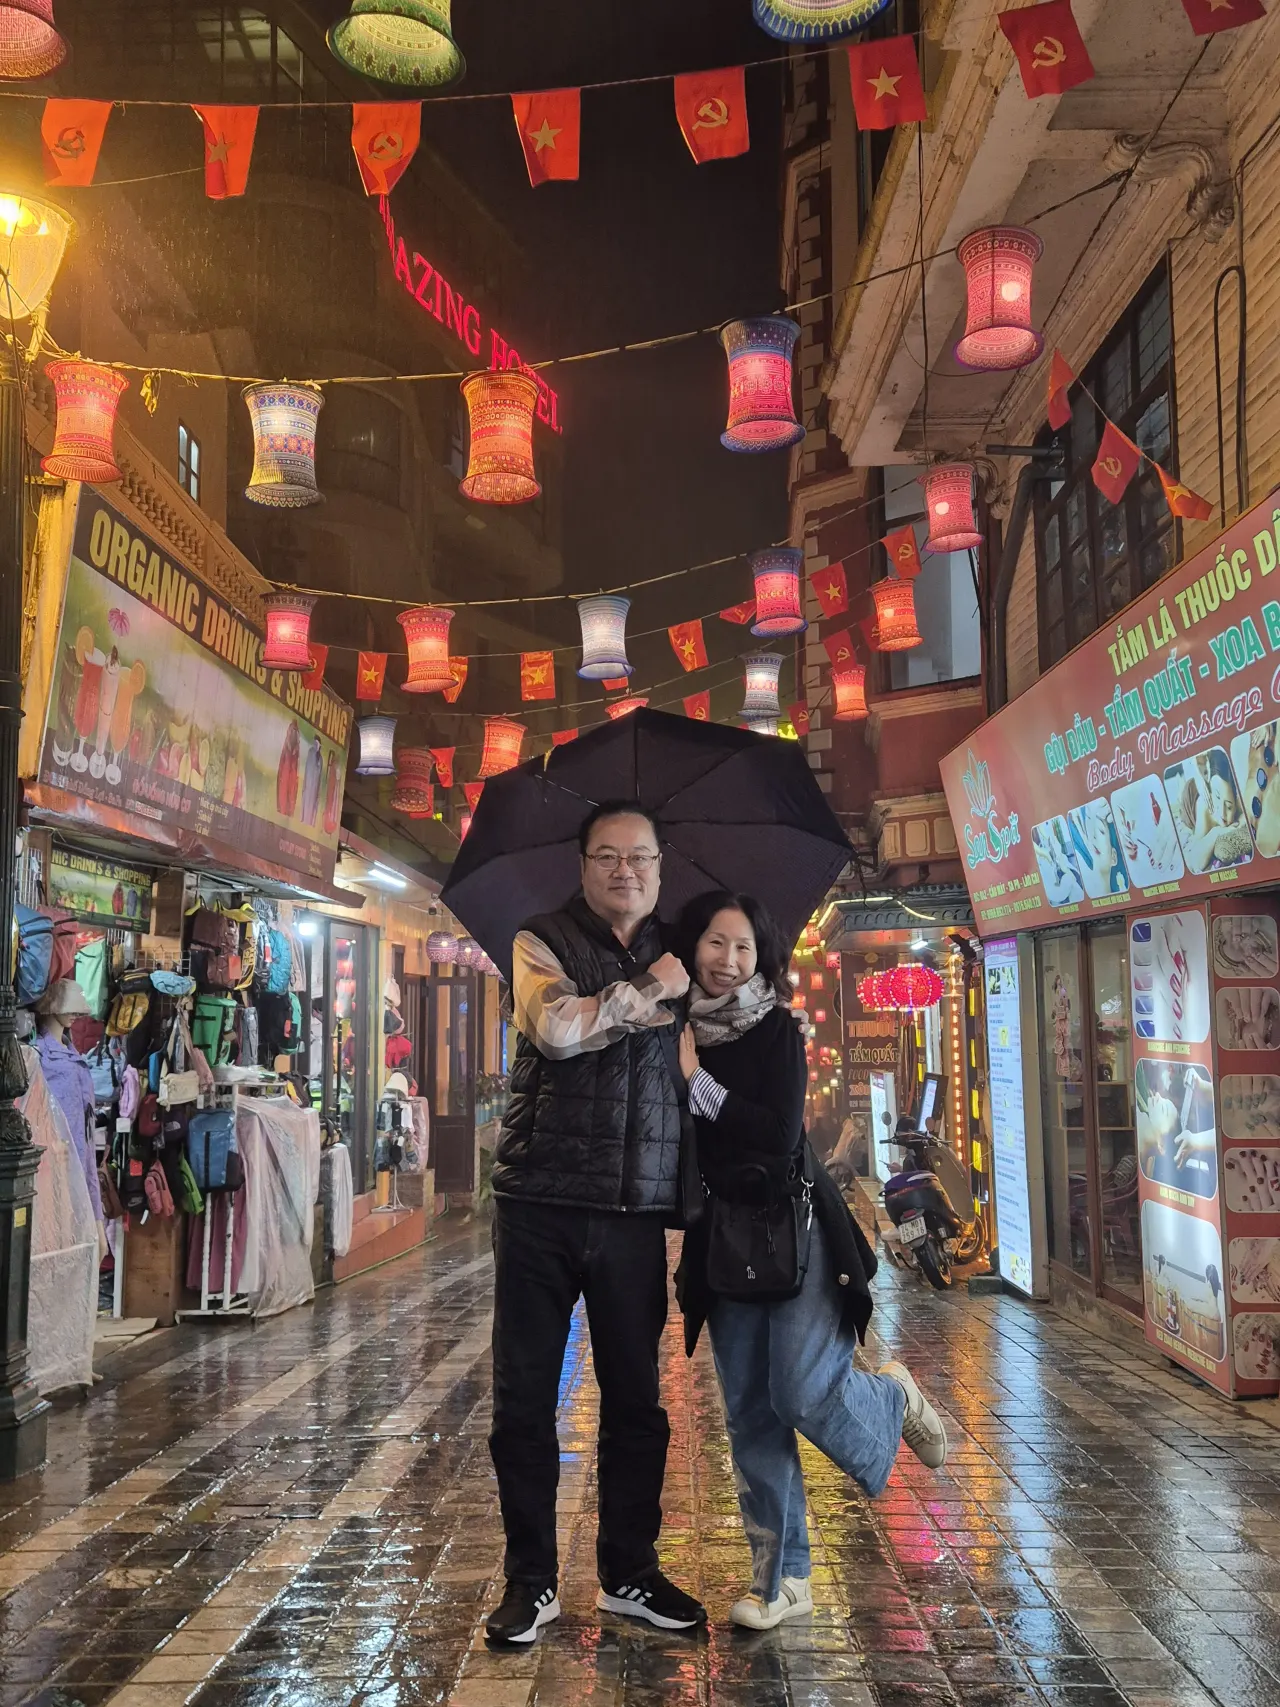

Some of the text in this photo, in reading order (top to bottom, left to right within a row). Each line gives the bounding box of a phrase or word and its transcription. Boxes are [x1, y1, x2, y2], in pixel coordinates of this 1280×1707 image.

[490, 328, 563, 435] HOEL
[90, 509, 348, 746] ORGANIC DRINKS & SHOPPING
[1107, 624, 1149, 676] TẮM
[1147, 597, 1178, 650] LÁ
[1174, 543, 1252, 630] THUỐC
[1044, 732, 1069, 776] GỘI
[1065, 712, 1098, 762] ĐẦU
[1143, 646, 1197, 720] QUẤT
[1208, 615, 1266, 682] XOA
[1087, 686, 1264, 793] Body Massage
[70, 853, 103, 876] DRINKS
[104, 864, 112, 877] &
[113, 865, 151, 887] SHOPPING
